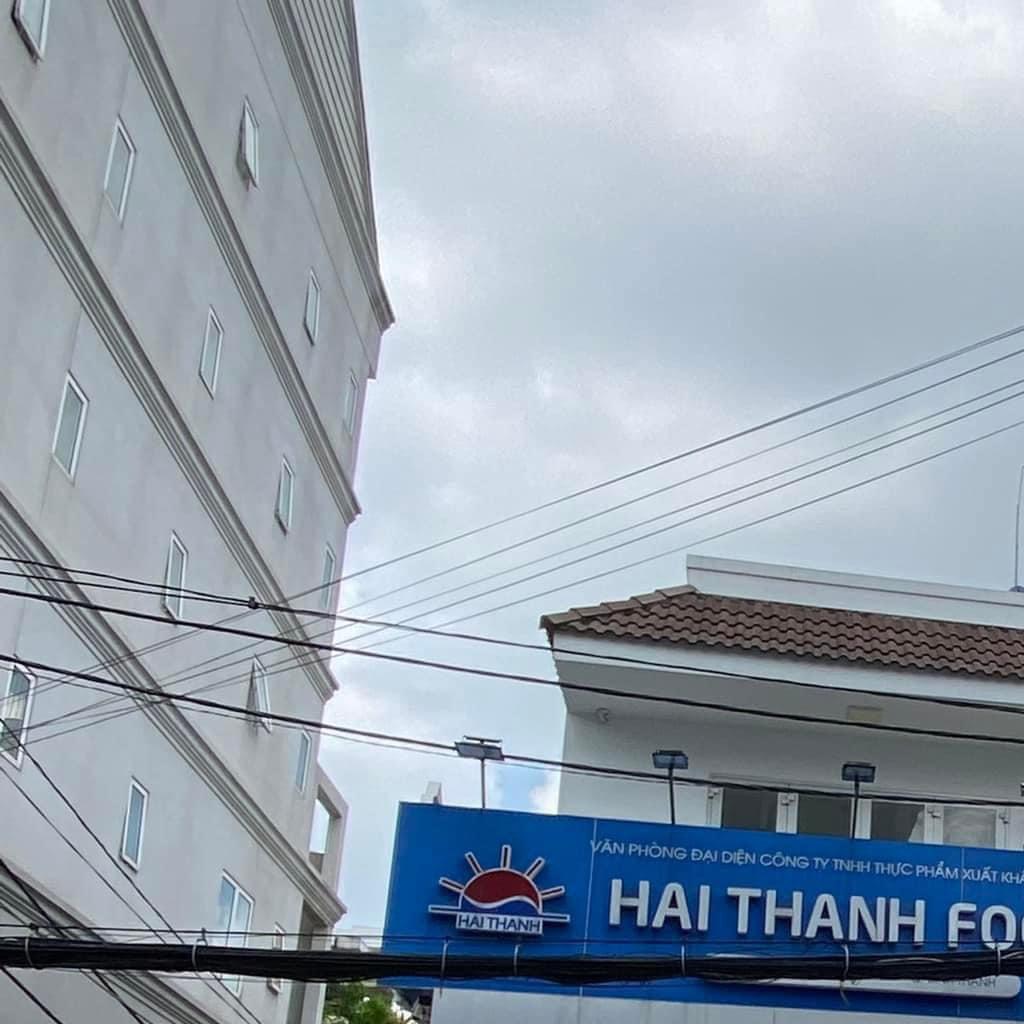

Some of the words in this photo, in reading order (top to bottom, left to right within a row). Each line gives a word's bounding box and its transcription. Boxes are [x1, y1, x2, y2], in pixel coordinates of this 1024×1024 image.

[590, 838, 625, 854] VĂN
[628, 841, 687, 860] PHÒNG
[691, 848, 718, 864] ĐẠI
[721, 848, 756, 866] DIỆN
[760, 851, 810, 869] CÔNG
[813, 857, 829, 870] TY
[831, 858, 871, 873] TNHH
[874, 861, 913, 877] THỰC
[915, 861, 959, 880] PHẨM
[961, 865, 998, 883] XUẤT
[458, 913, 484, 929] HAI
[487, 916, 541, 932] THANH
[609, 878, 711, 932] HAI
[727, 886, 926, 946] THANH
